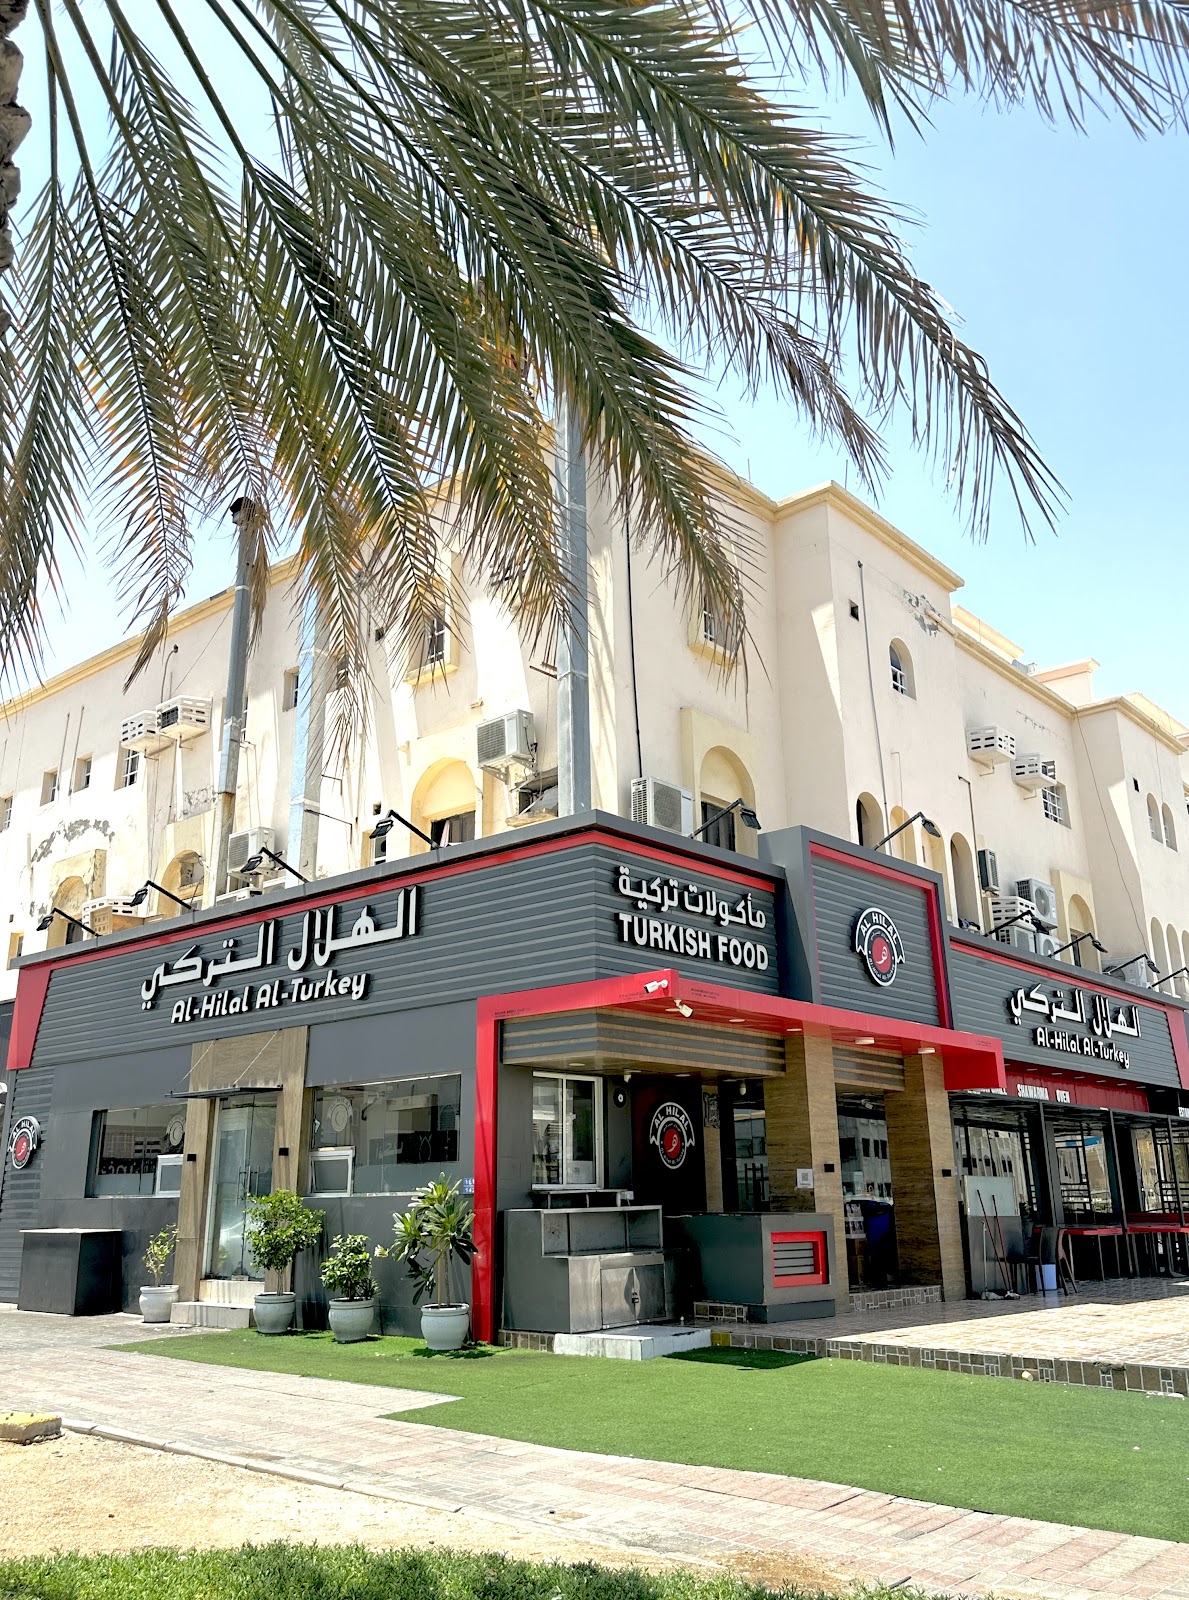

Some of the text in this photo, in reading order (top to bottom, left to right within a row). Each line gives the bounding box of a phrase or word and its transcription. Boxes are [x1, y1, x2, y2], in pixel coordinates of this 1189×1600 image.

[618, 865, 767, 929] مأكولات تركية
[141, 885, 417, 1010] الهلال التركي
[618, 912, 769, 971] TURKISH FOOD
[860, 918, 871, 936] AL
[872, 912, 898, 944] HILAL
[170, 968, 367, 1024] Al-Hilal Al-Turkey
[1010, 983, 1142, 1039] الهلال التركي
[1036, 1026, 1130, 1070] Al-Hilal Al-Turkey
[654, 1113, 665, 1129] AL
[665, 1106, 689, 1131] HILAL
